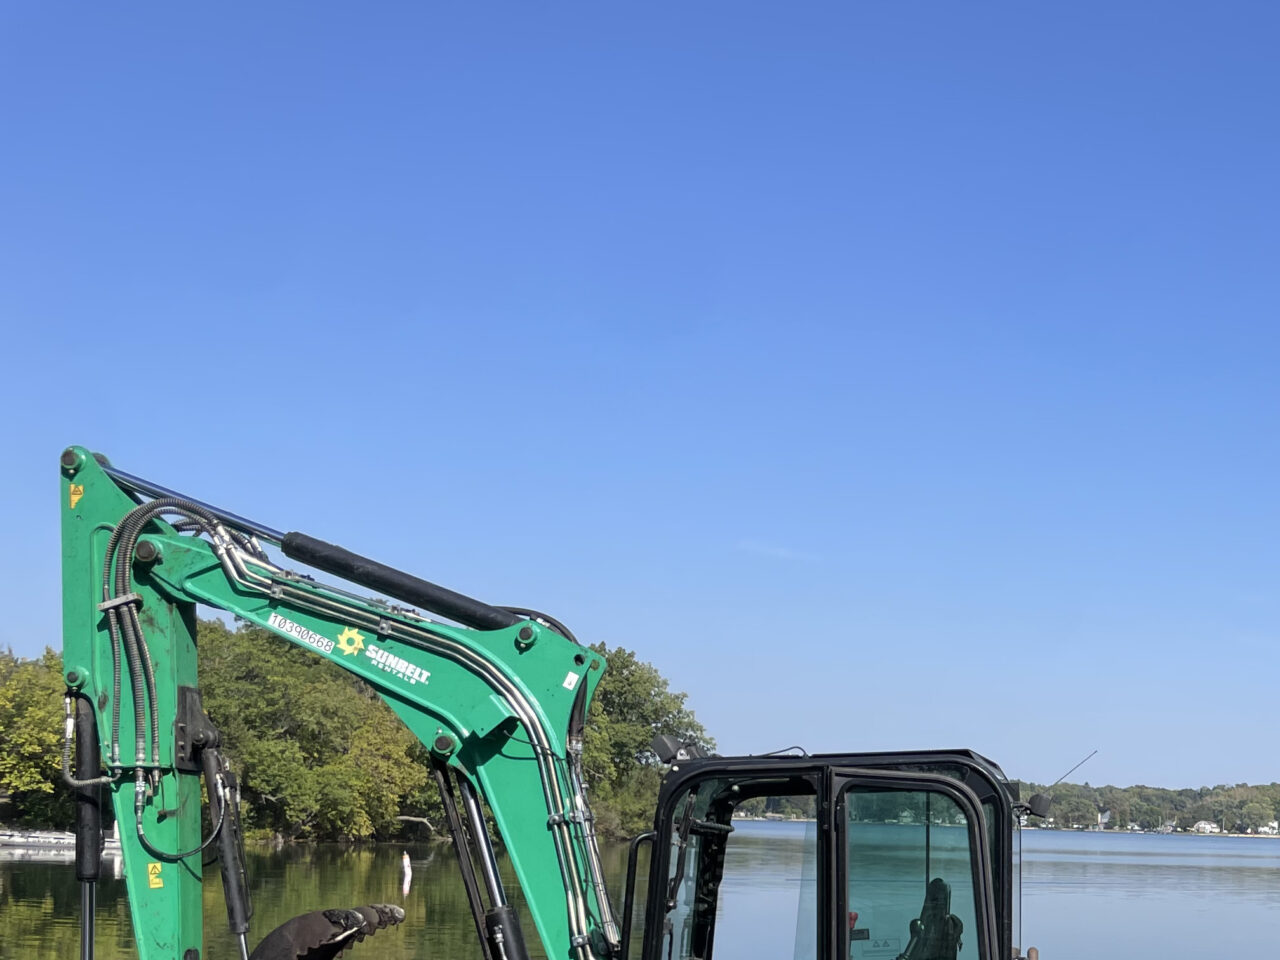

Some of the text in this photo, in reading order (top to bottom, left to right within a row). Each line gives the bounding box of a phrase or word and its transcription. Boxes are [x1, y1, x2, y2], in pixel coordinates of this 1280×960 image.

[271, 614, 333, 652] 10390668
[365, 644, 431, 683] SUNBELT
[371, 659, 417, 685] RENTALS
